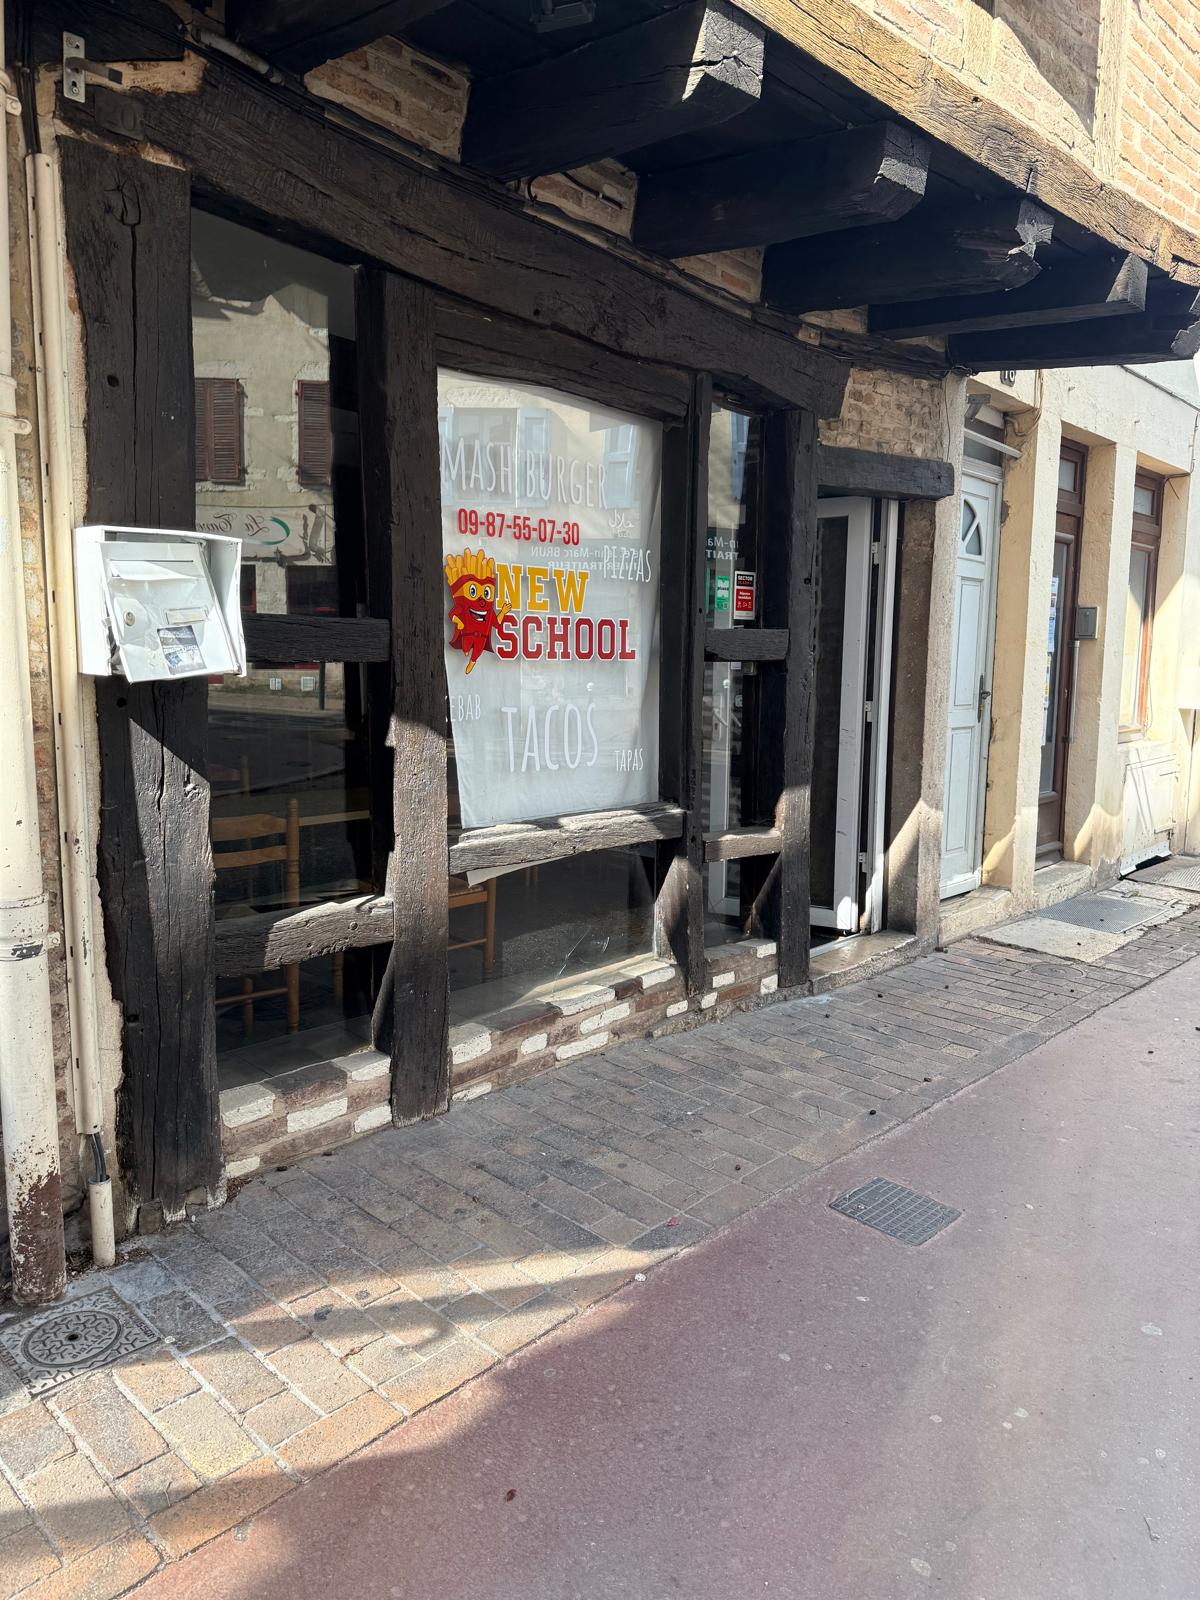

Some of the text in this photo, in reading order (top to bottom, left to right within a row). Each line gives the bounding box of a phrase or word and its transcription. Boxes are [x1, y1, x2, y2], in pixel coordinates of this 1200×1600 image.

[525, 451, 608, 509] BURGER
[458, 508, 580, 546] 09-87-55-07-30
[603, 545, 651, 583] PIZZAS
[495, 563, 590, 614] NEW
[495, 614, 636, 661] SCHOOL
[501, 703, 599, 772] TACOS
[615, 748, 643, 772] TAPAS
